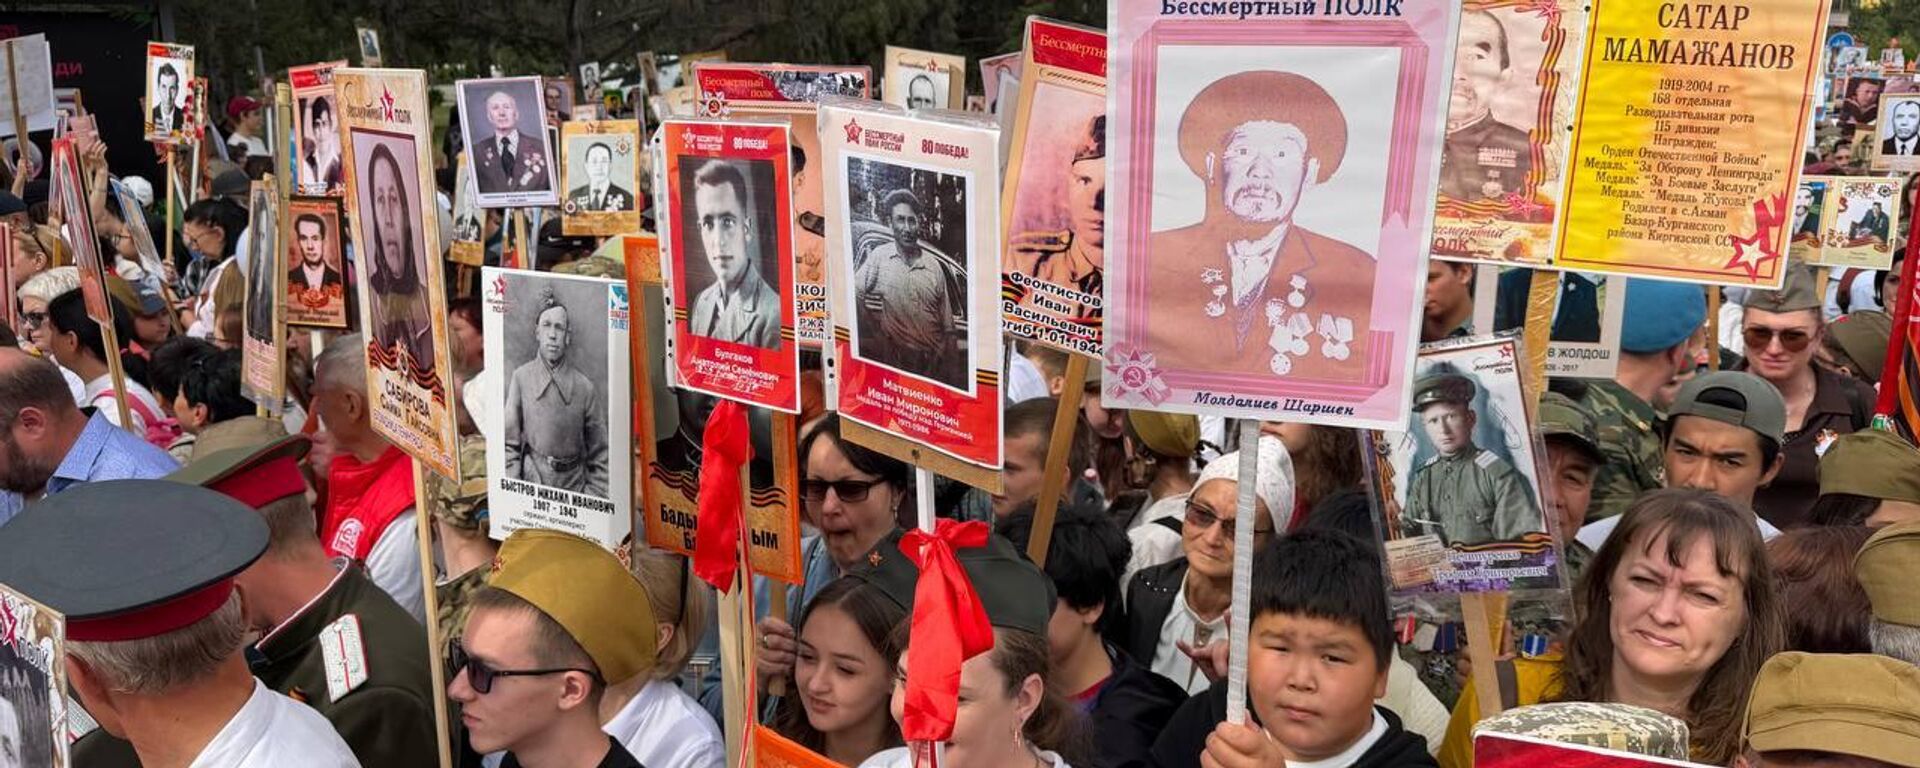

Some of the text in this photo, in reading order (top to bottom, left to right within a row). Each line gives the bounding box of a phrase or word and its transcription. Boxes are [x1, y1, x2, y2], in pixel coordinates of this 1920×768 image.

[1160, 0, 1401, 19] Бессмертный ПОЛК
[1658, 3, 1749, 31] САТАР
[1040, 33, 1106, 58] Бессмертн
[1602, 37, 1795, 70] МАМАЖАНОВ
[1659, 78, 1713, 93] 1919-2004
[1652, 92, 1732, 108] 168 отдельная
[1625, 105, 1755, 125] Разведывательная рота
[1654, 120, 1721, 136] 115 дивизии
[921, 138, 970, 159] 80 ПОБЕДА!
[1653, 134, 1717, 149] Награжден:
[1601, 144, 1634, 158] Орден
[1638, 147, 1719, 163] Отечественной
[1584, 157, 1628, 170] Медаль:
[1657, 163, 1703, 177] Оборону
[1595, 171, 1640, 185] Медаль:
[1668, 176, 1708, 190] Боевые
[1600, 185, 1645, 199] Медаль:
[1621, 200, 1666, 213] Родился
[1681, 205, 1728, 219] с.Акман
[1624, 215, 1726, 232] Базар-Курганского
[1435, 237, 1469, 252] ОЛК
[1607, 229, 1643, 240] района
[1648, 229, 1711, 246] Киргизской
[1010, 271, 1102, 307] Феоктистов
[1034, 293, 1072, 315] Иван
[800, 318, 824, 327] РЖА
[1004, 301, 1097, 338] Васильевич
[714, 347, 753, 364] Булгаков
[1558, 348, 1611, 360] ЖОЛДОШ
[384, 378, 432, 420] САБИРОВА
[882, 378, 944, 407] Матвиенко
[867, 386, 960, 428] Иван Миронович
[1193, 391, 1355, 416] Молдалиев Шаршен
[501, 478, 616, 515] БЫСТРОВ МИХАИЛ ИВАНОВИЧ
[559, 505, 578, 518] 1943
[660, 503, 778, 550] Бады ым
